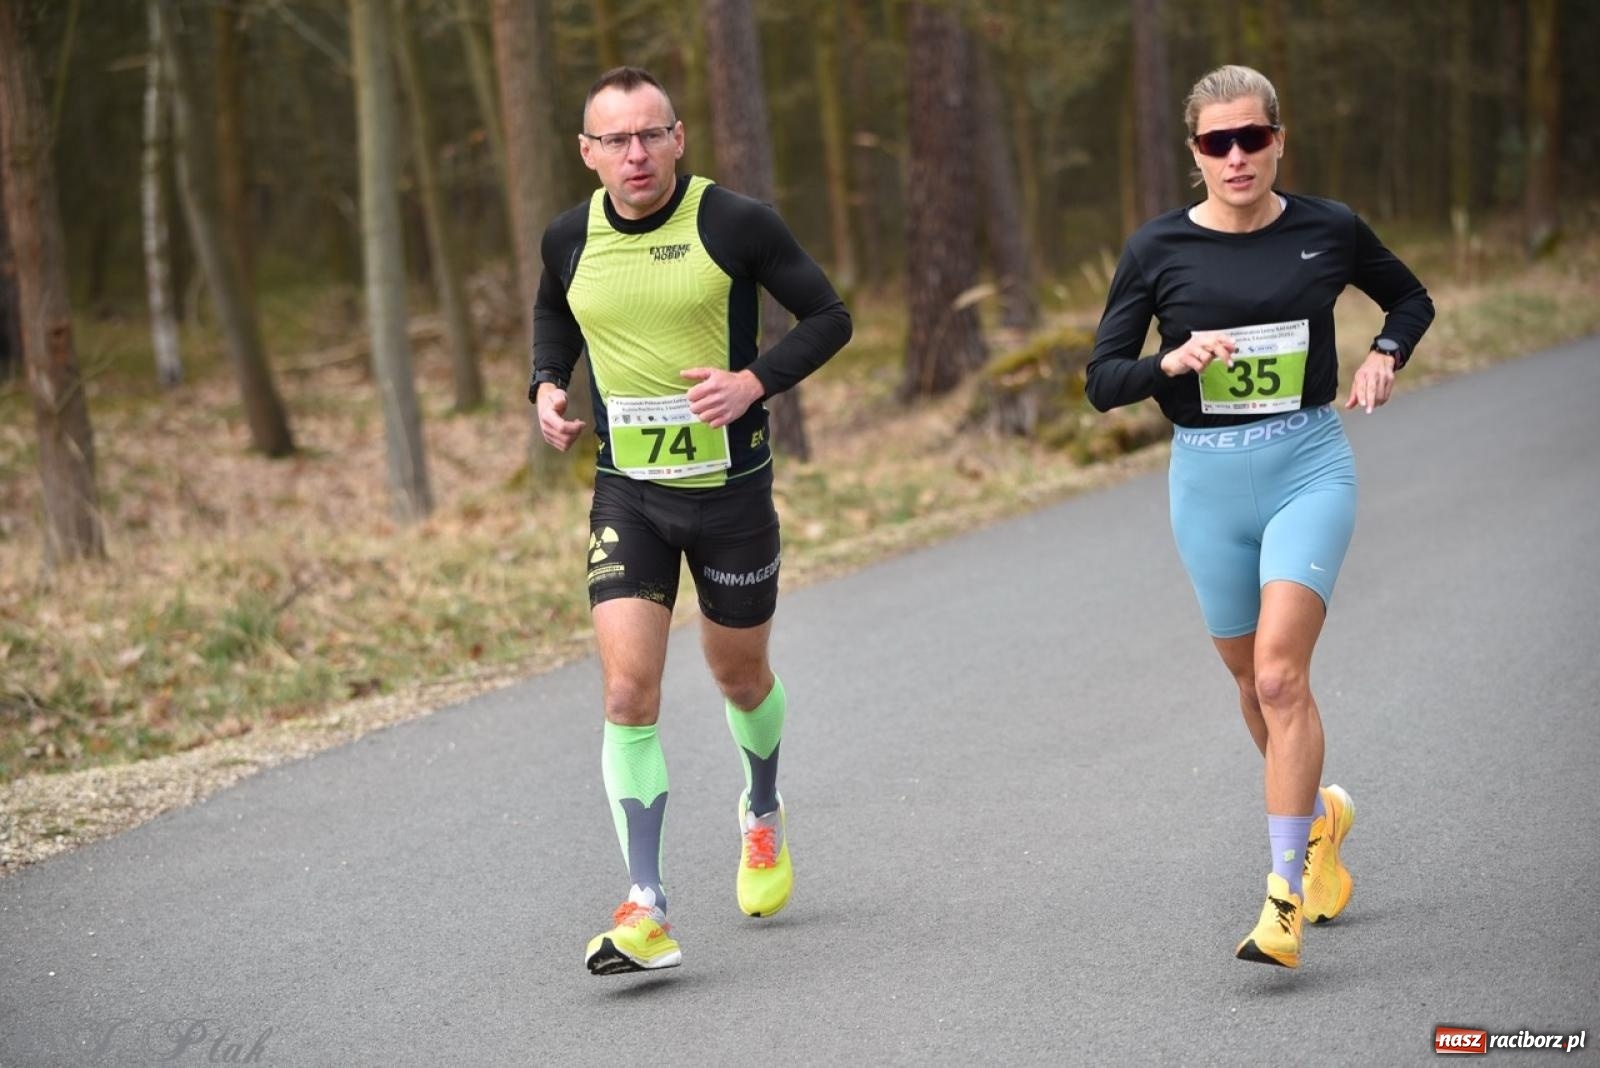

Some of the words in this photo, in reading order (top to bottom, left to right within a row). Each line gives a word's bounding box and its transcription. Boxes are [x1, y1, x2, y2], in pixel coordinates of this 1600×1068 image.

[649, 243, 691, 255] EXTREME
[654, 250, 687, 261] HOBBY
[1227, 357, 1281, 398] 35
[641, 426, 697, 463] 74
[1176, 431, 1239, 449] NIKE
[1242, 412, 1309, 446] PRO
